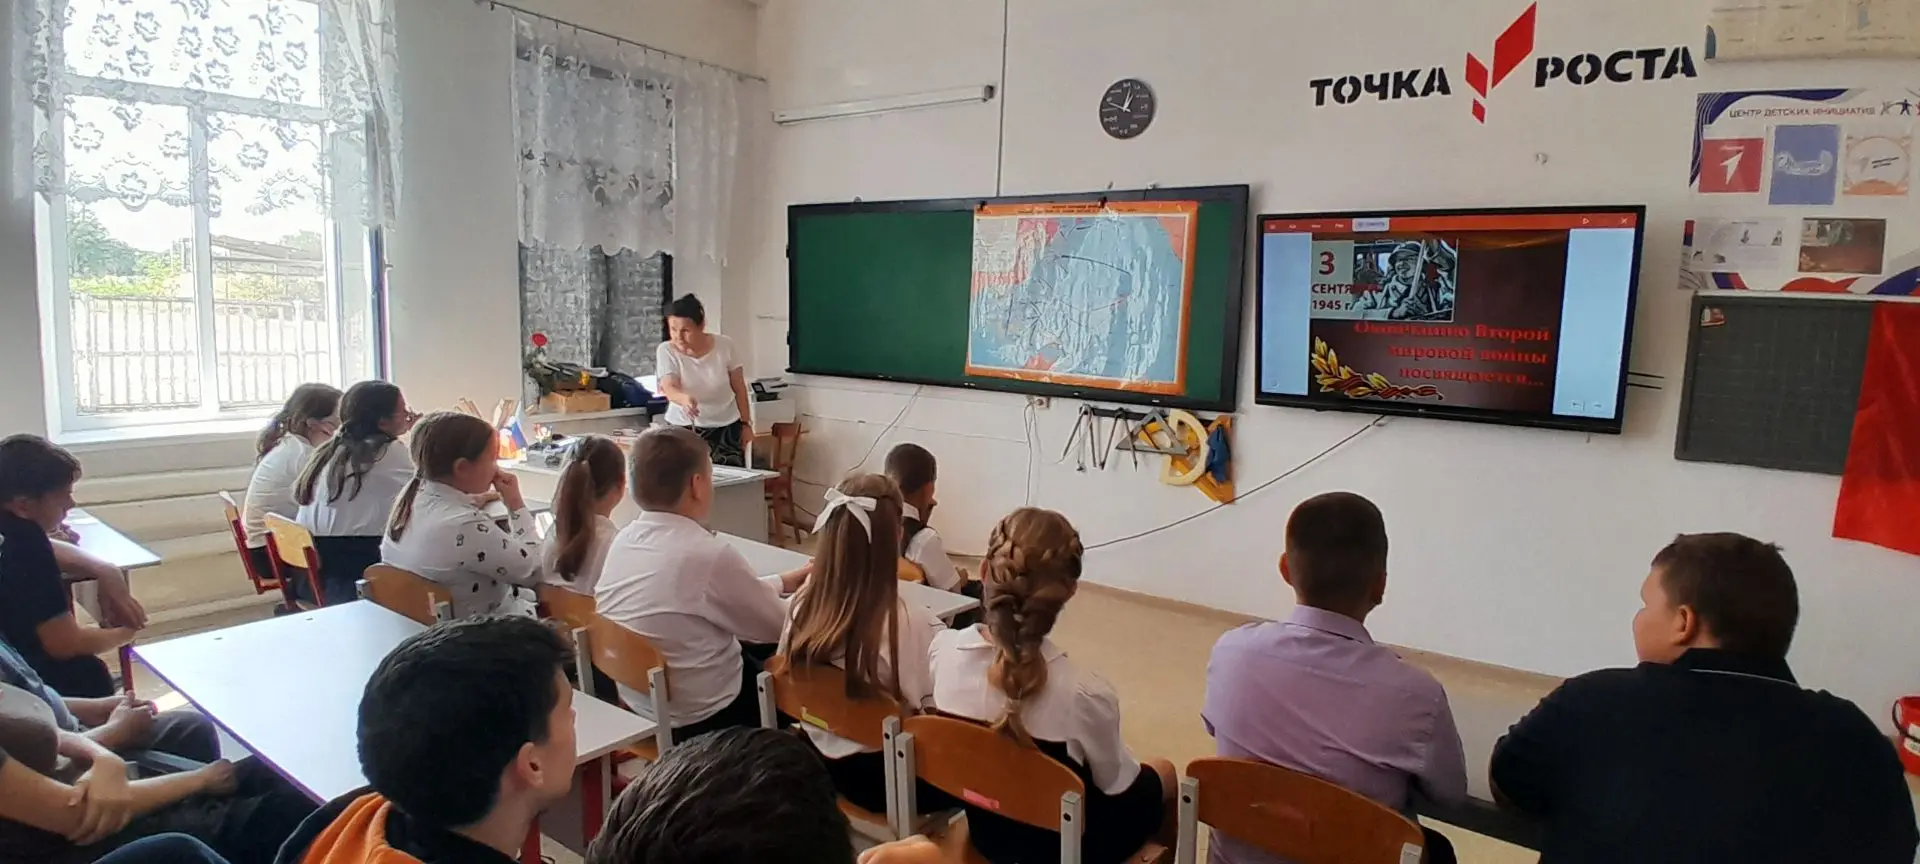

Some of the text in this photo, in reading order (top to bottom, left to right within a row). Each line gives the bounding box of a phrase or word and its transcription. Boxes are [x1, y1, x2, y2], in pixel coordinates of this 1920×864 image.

[1309, 46, 1698, 107] ТОЧКА РОСТА
[1728, 106, 1876, 118] ЦЕНТР ДЕТСКИХ ИНИЦИАТИВ
[1318, 251, 1336, 276] 3
[1312, 299, 1342, 311] 1945
[1475, 323, 1550, 342] Второй
[1388, 345, 1547, 364] мировой войны
